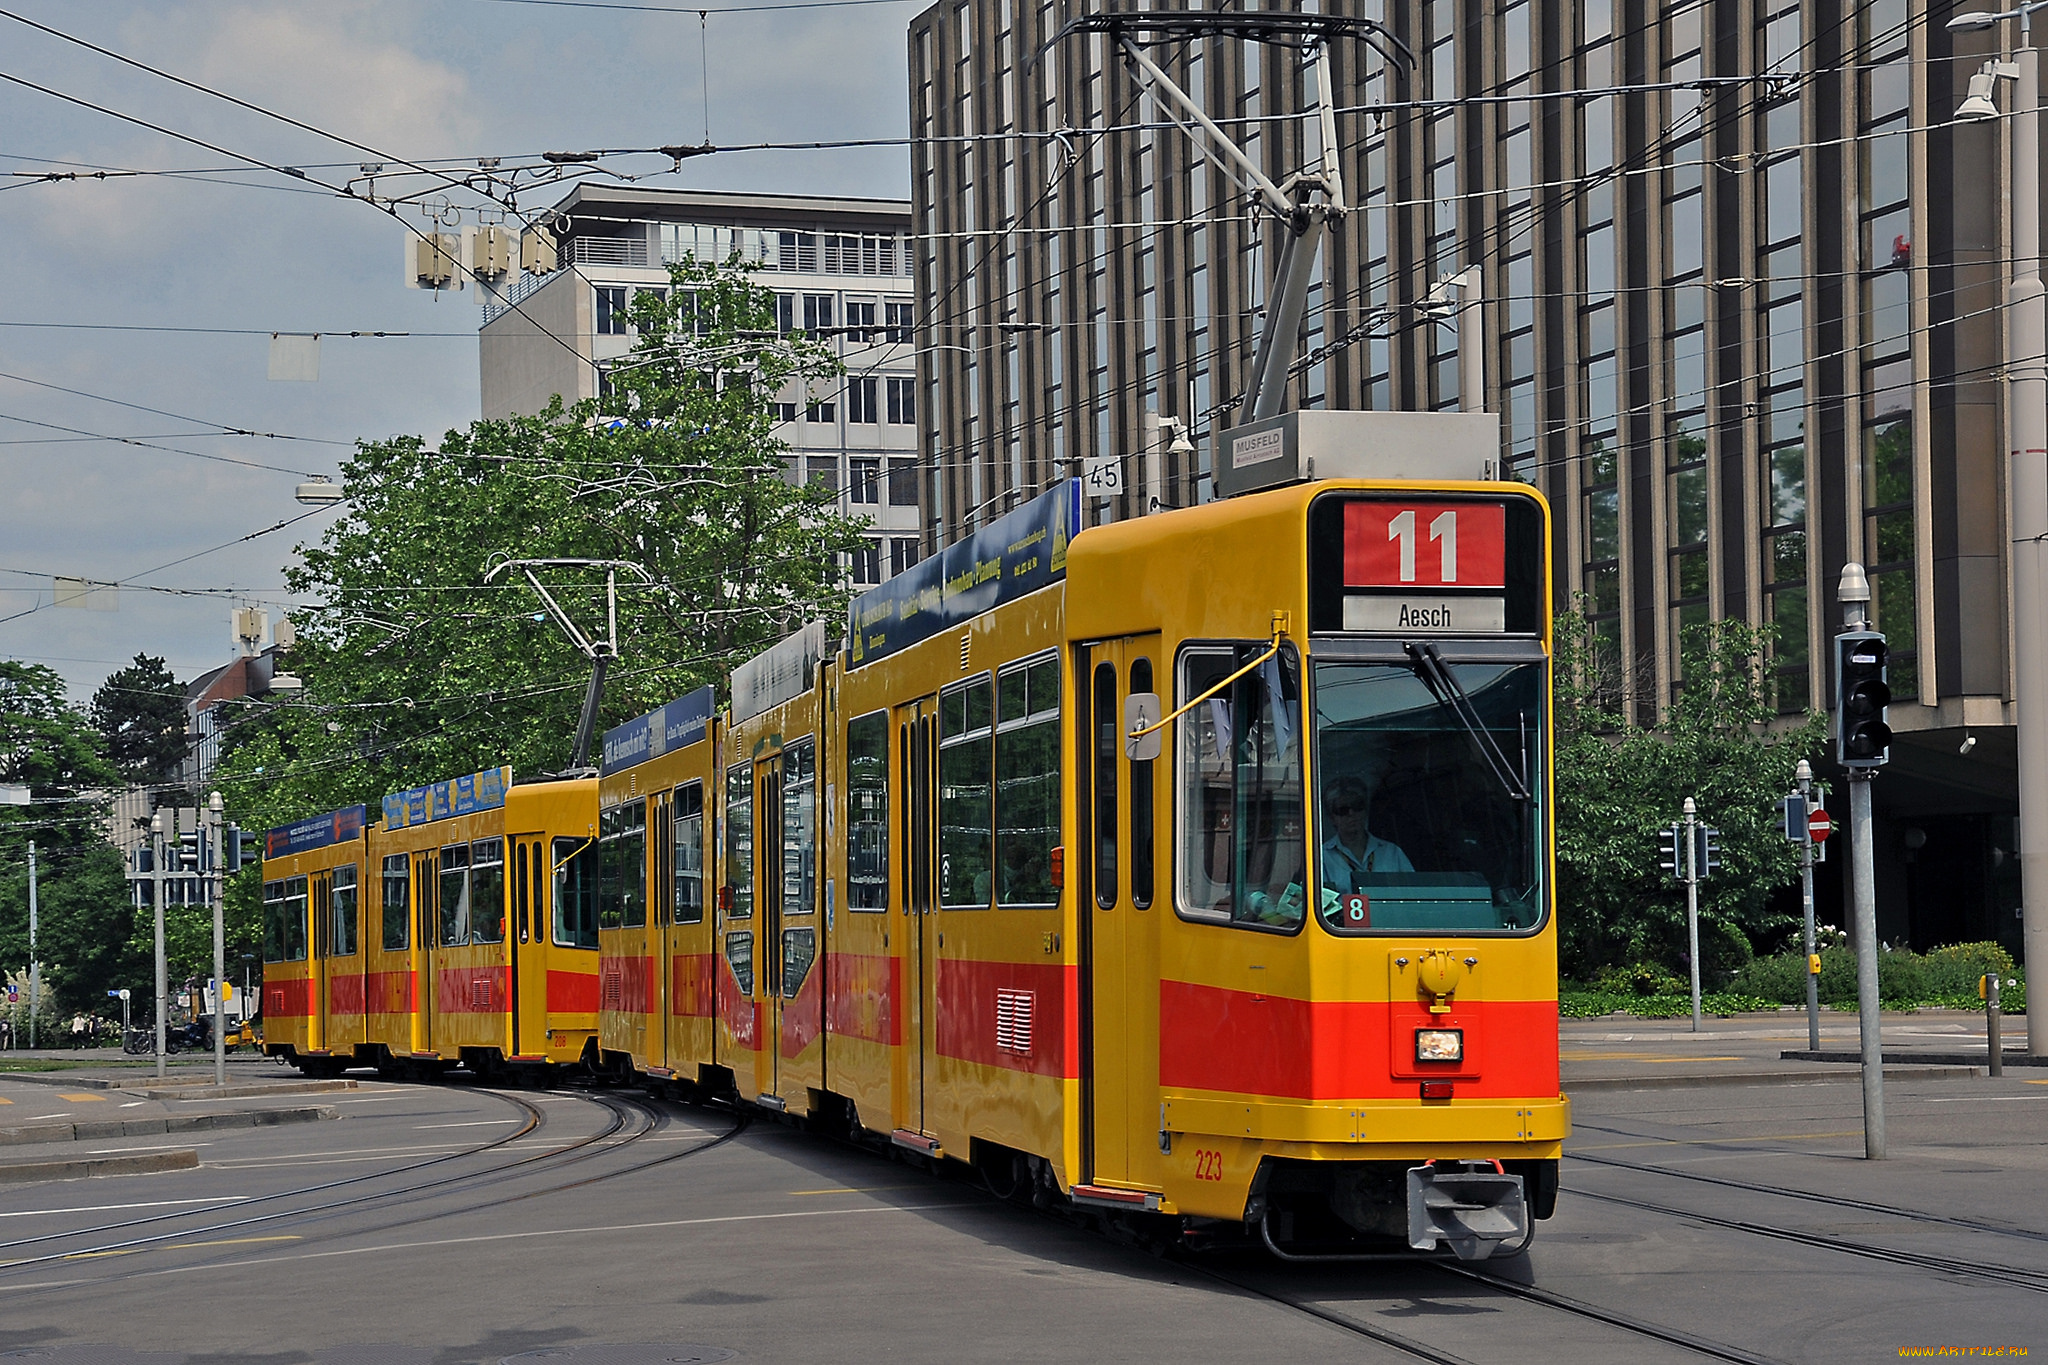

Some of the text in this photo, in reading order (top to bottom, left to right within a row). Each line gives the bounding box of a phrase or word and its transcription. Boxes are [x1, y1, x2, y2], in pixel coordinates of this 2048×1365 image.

[1236, 433, 1280, 453] MUSFELD
[1091, 464, 1117, 488] 45
[1388, 510, 1457, 582] 11
[1398, 604, 1451, 627] Aesch
[1349, 898, 1364, 921] 8
[1195, 1149, 1222, 1181] 223
